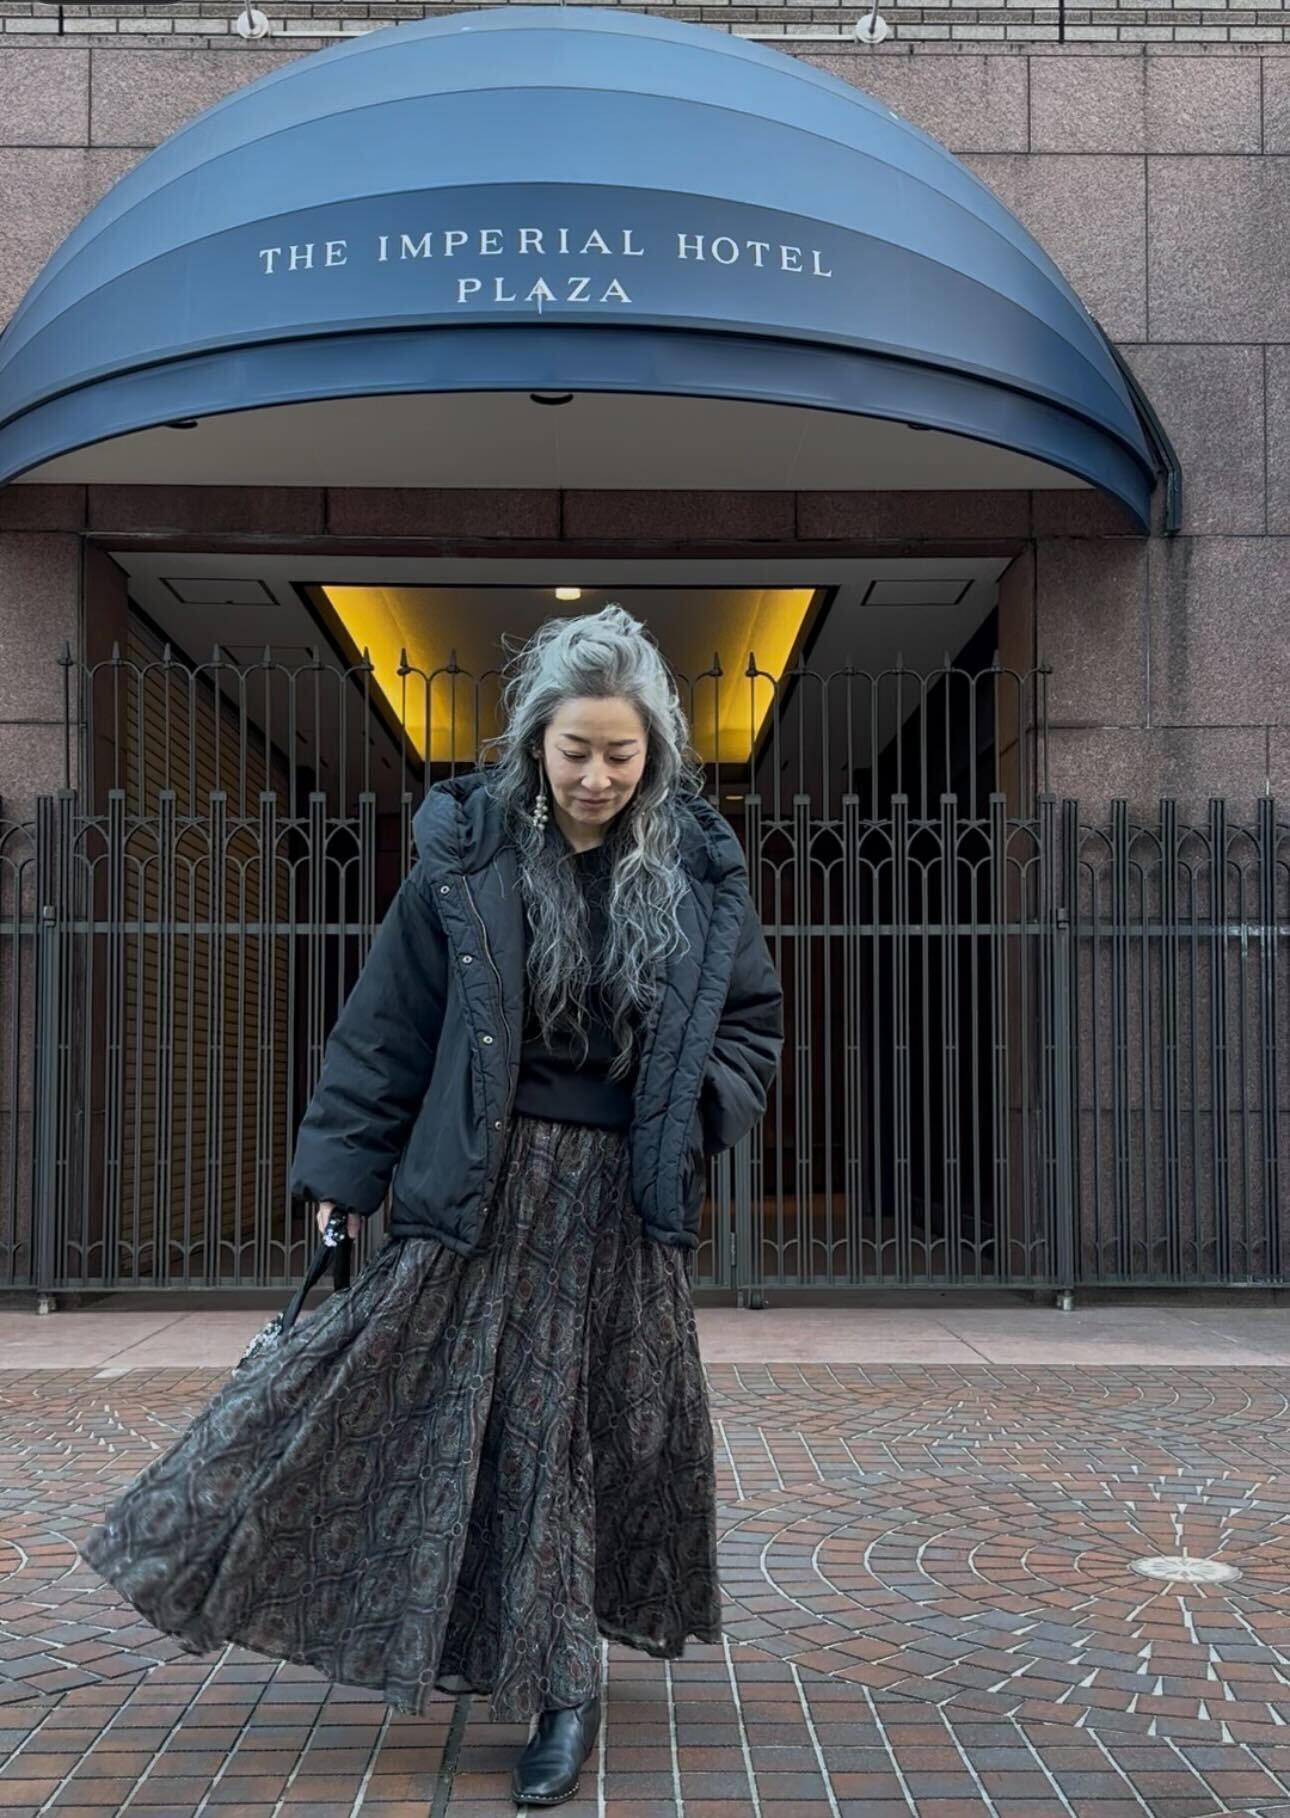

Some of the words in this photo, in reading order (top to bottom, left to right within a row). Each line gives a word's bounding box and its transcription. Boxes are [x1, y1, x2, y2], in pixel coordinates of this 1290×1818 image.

[258, 239, 349, 276] THE
[378, 227, 645, 262] IMPERIAL
[677, 232, 834, 279] HOTEL
[456, 276, 633, 305] PLAZA
